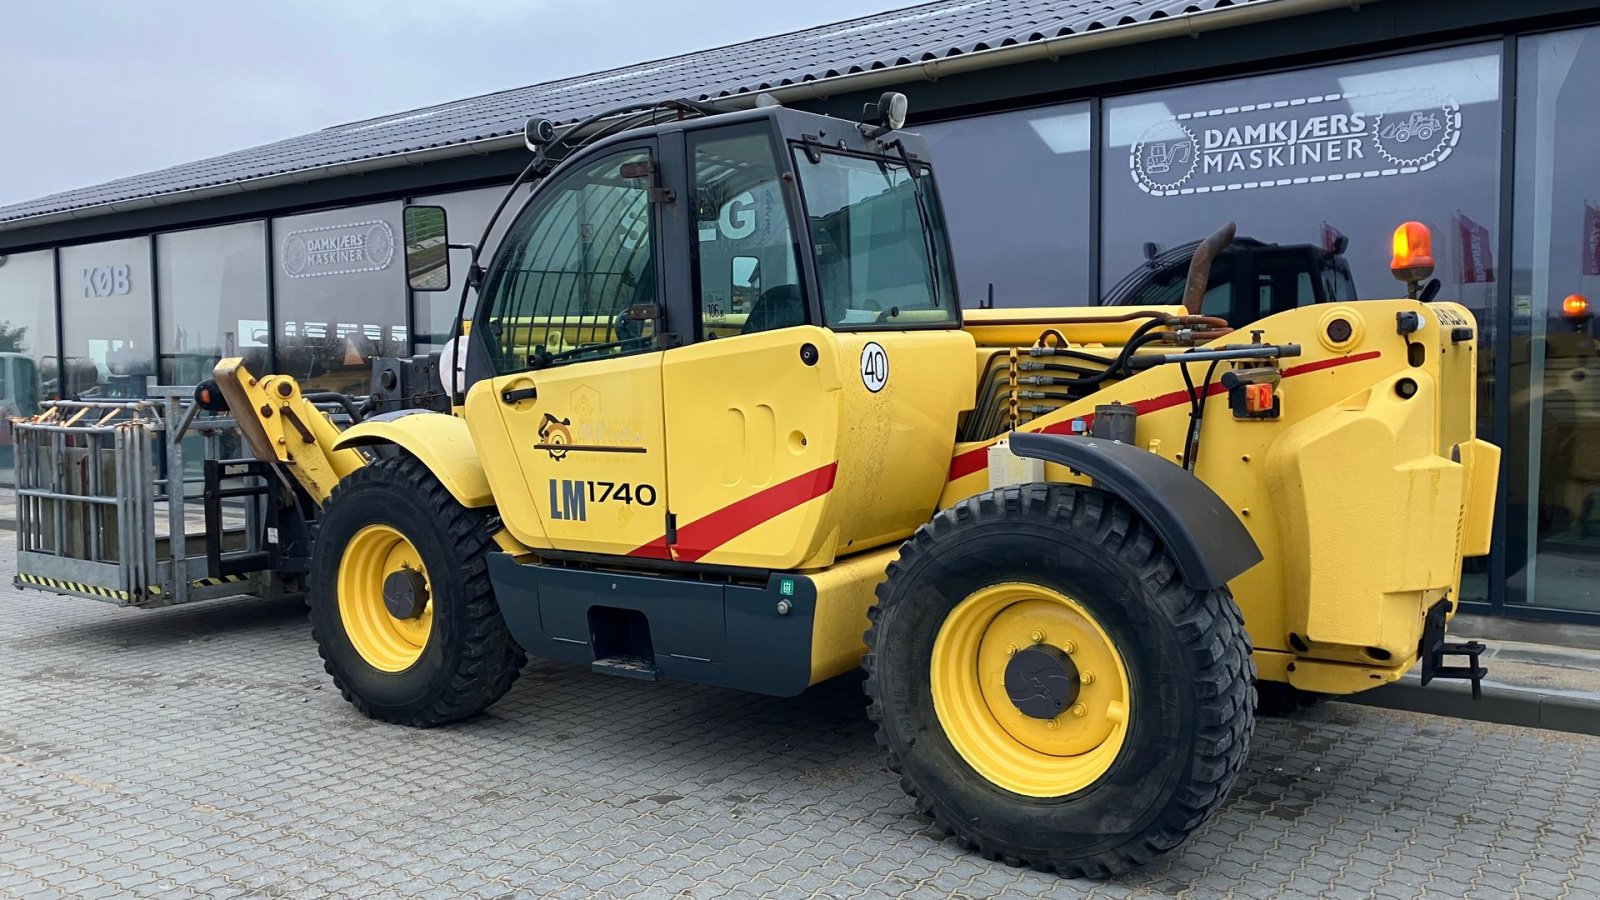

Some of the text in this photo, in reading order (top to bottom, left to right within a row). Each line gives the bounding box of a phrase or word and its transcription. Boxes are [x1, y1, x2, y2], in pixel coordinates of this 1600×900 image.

[1203, 112, 1366, 149] DAMKJÆRS
[1203, 138, 1364, 174] MASKINER
[307, 234, 364, 252] DAMKJÆRS
[307, 249, 364, 266] MASKINER
[81, 264, 131, 298] KØB
[864, 351, 885, 383] 40
